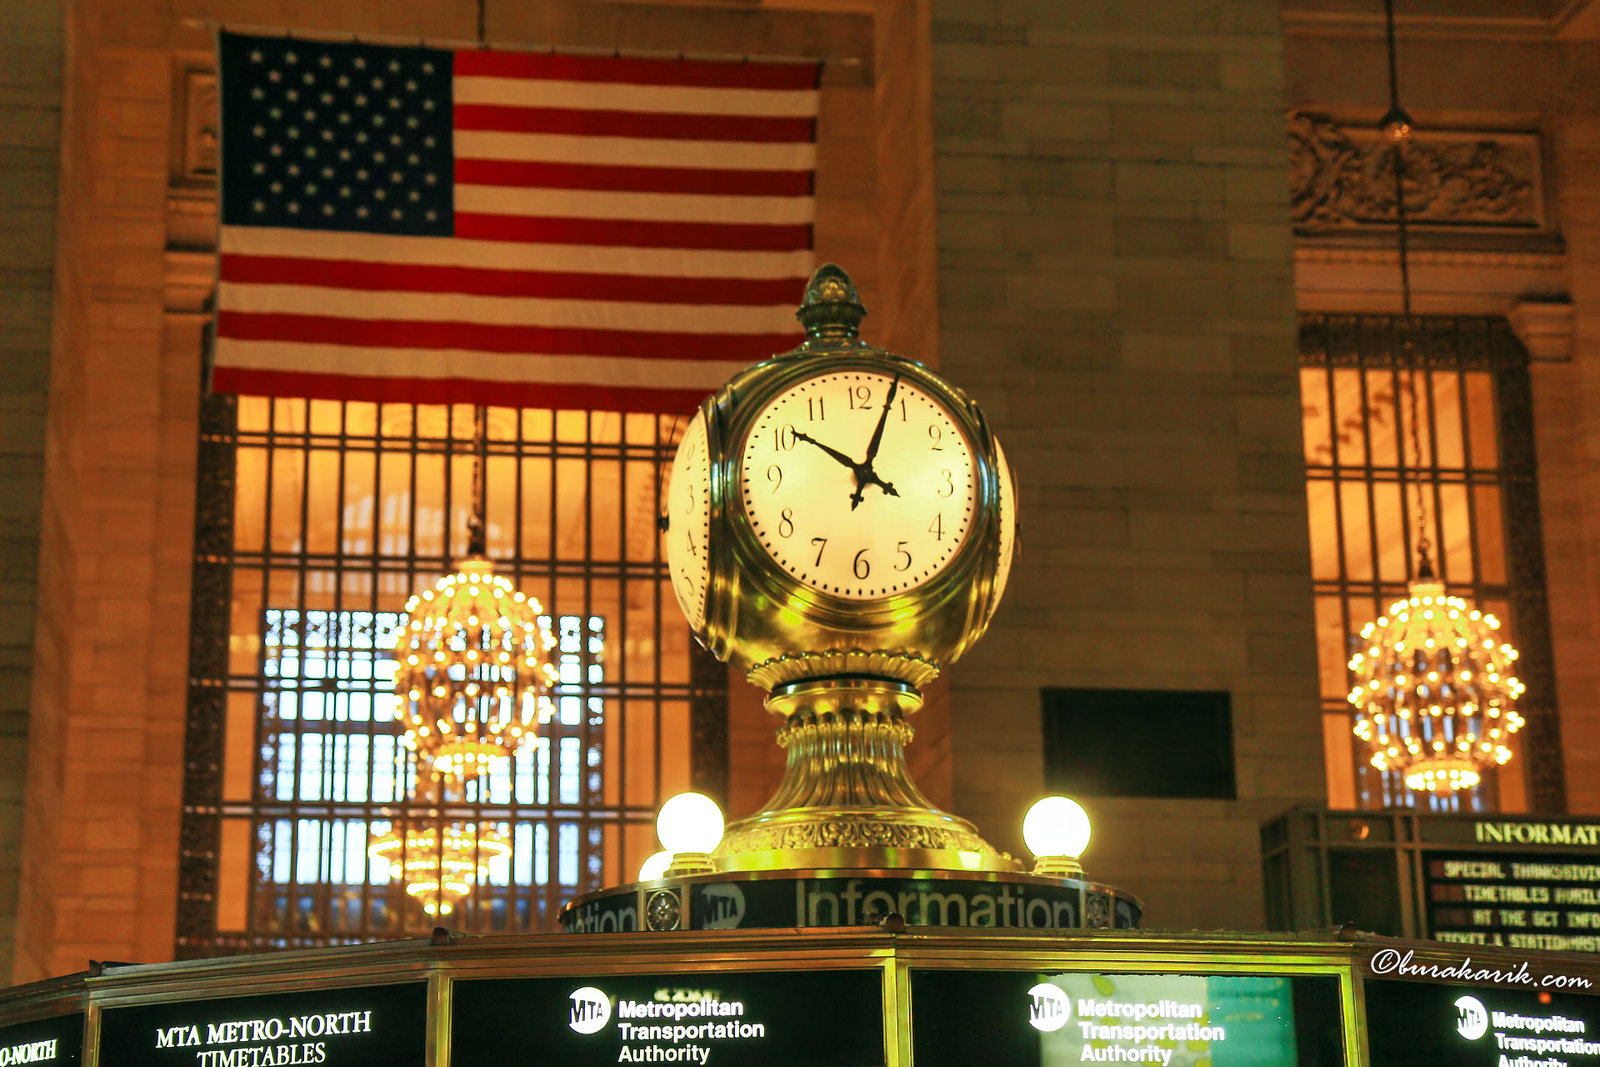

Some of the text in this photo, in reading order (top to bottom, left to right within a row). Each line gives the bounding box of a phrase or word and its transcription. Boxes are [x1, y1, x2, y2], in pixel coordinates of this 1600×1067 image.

[808, 396, 825, 422] 11
[848, 385, 873, 411] 12
[900, 398, 907, 422] 1
[773, 423, 797, 452] 10
[928, 424, 943, 451] 2
[766, 464, 783, 496] 9
[937, 468, 954, 498] 3
[778, 507, 794, 538] 8
[928, 512, 945, 541] 4
[811, 537, 828, 567] 7
[853, 548, 871, 579] 6
[893, 541, 912, 572] 5
[1444, 860, 1506, 879] SPECIAL
[796, 879, 1076, 928] Information
[1464, 884, 1549, 903] TIMETABLES
[1473, 909, 1492, 926] AT
[1499, 909, 1526, 927] THE
[618, 999, 744, 1021] Metropolitan
[1078, 998, 1203, 1019] Metropolitan
[155, 1010, 372, 1049] MTA METRO-NORTH
[617, 1020, 765, 1043] Transportation
[1078, 1021, 1226, 1043] Transportation
[1491, 1010, 1585, 1034] Metropolitan
[196, 1042, 326, 1067] TIMETABLES
[617, 1044, 711, 1065] Authority
[1080, 1044, 1173, 1067] Authority
[1494, 1032, 1600, 1055] Transportation
